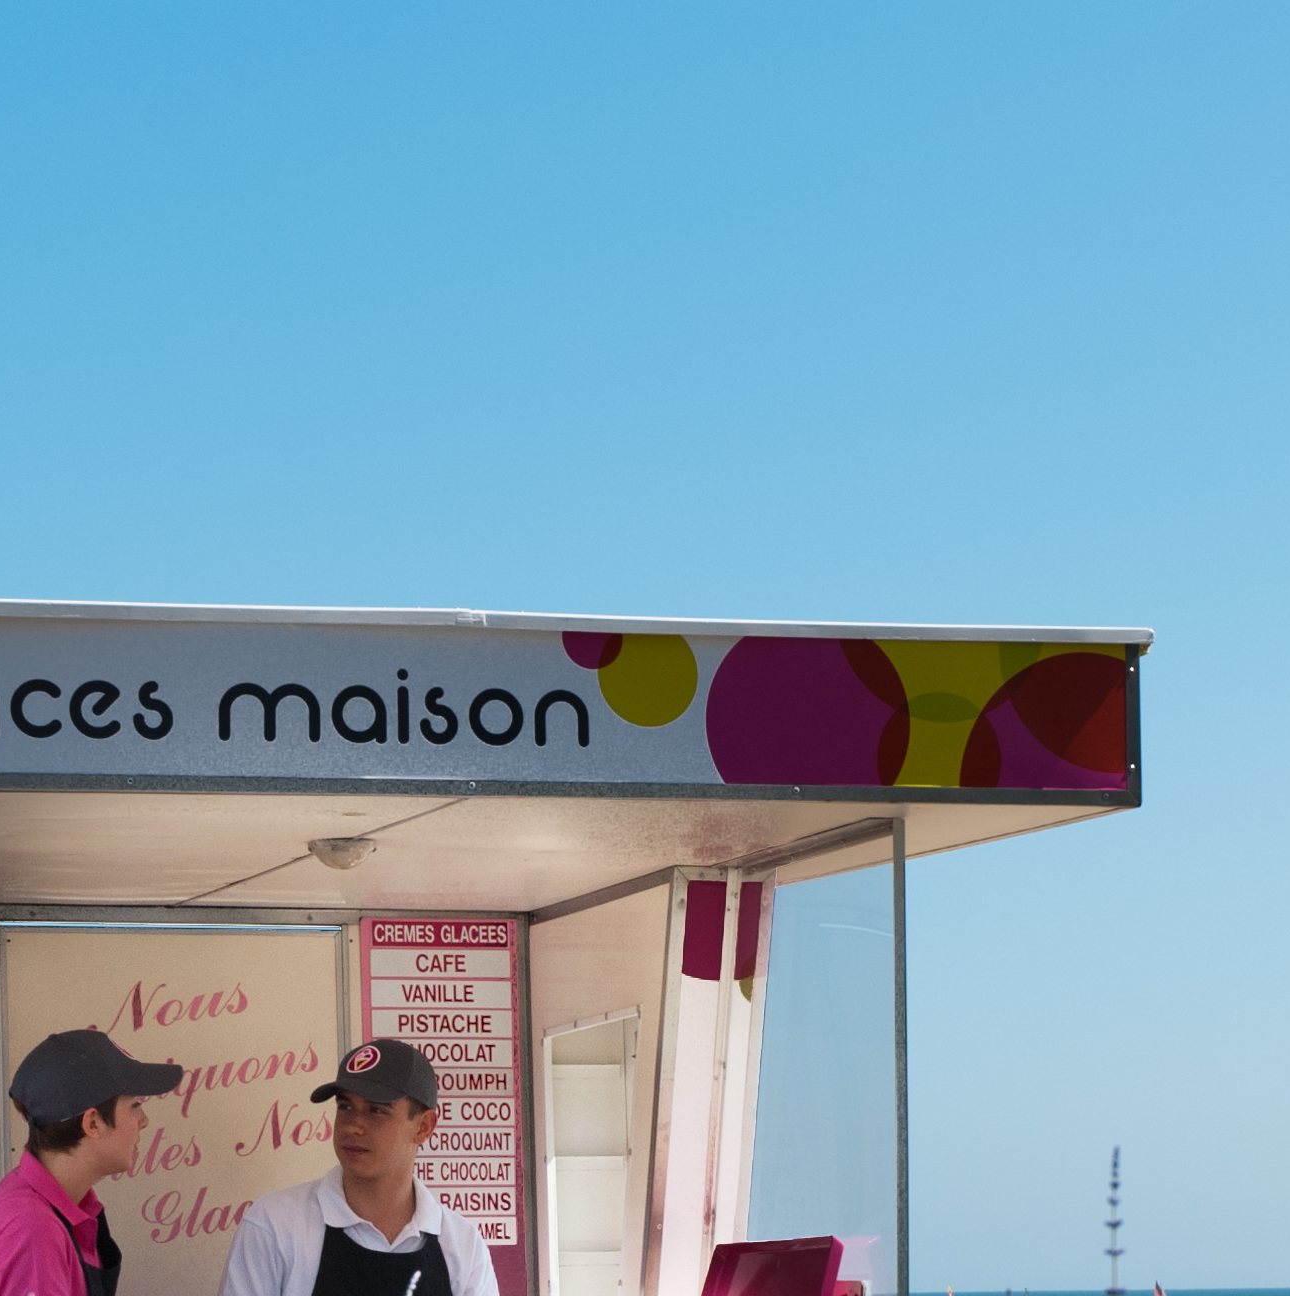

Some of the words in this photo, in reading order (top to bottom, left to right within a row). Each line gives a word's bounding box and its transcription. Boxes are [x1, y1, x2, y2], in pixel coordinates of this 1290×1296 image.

[218, 668, 590, 747] maison
[374, 924, 435, 943] CREMES
[440, 925, 507, 944] GLACEES
[415, 954, 466, 973] CAFE
[401, 984, 474, 1003] VANILLE
[86, 980, 248, 1035] Nous
[398, 1014, 492, 1033] PISTACHE
[460, 1102, 511, 1121] COCO
[234, 1100, 333, 1157] Nos
[429, 1132, 511, 1151] CROQUANT
[440, 1162, 511, 1181] CHOCOLAT
[440, 1192, 512, 1211] RAISINS
